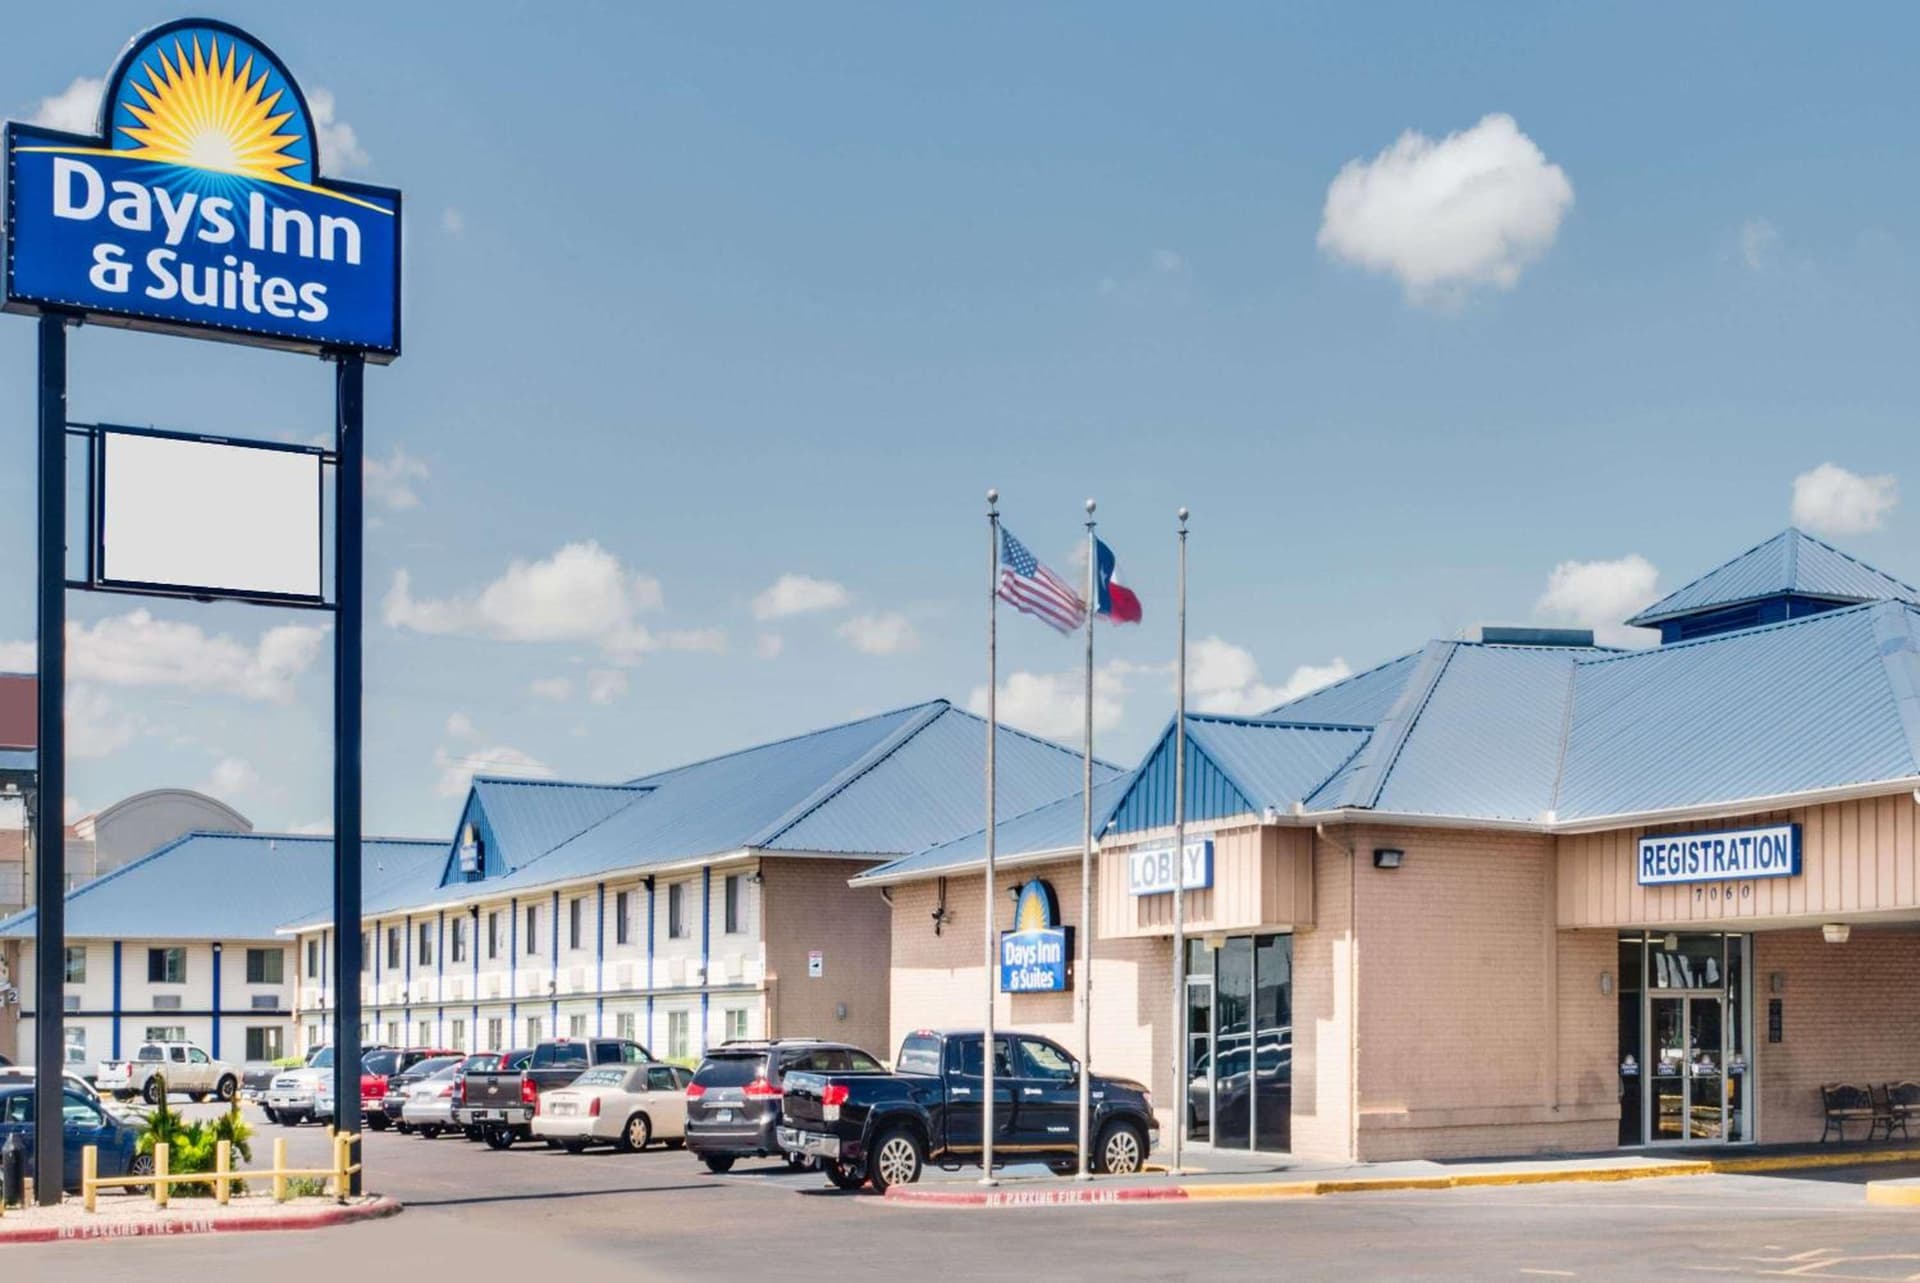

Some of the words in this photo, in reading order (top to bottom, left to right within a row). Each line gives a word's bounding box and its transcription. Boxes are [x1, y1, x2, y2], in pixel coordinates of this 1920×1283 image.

[53, 157, 235, 246] Days
[249, 192, 361, 265] Inn
[89, 243, 133, 293] &
[145, 248, 329, 322] Suites
[1130, 845, 1202, 889] LOBY
[1642, 833, 1788, 877] REGISTRATION
[1695, 884, 1751, 902] 7060
[1005, 941, 1036, 969] Days
[1038, 940, 1061, 964] Inn
[1020, 966, 1055, 990] Suites
